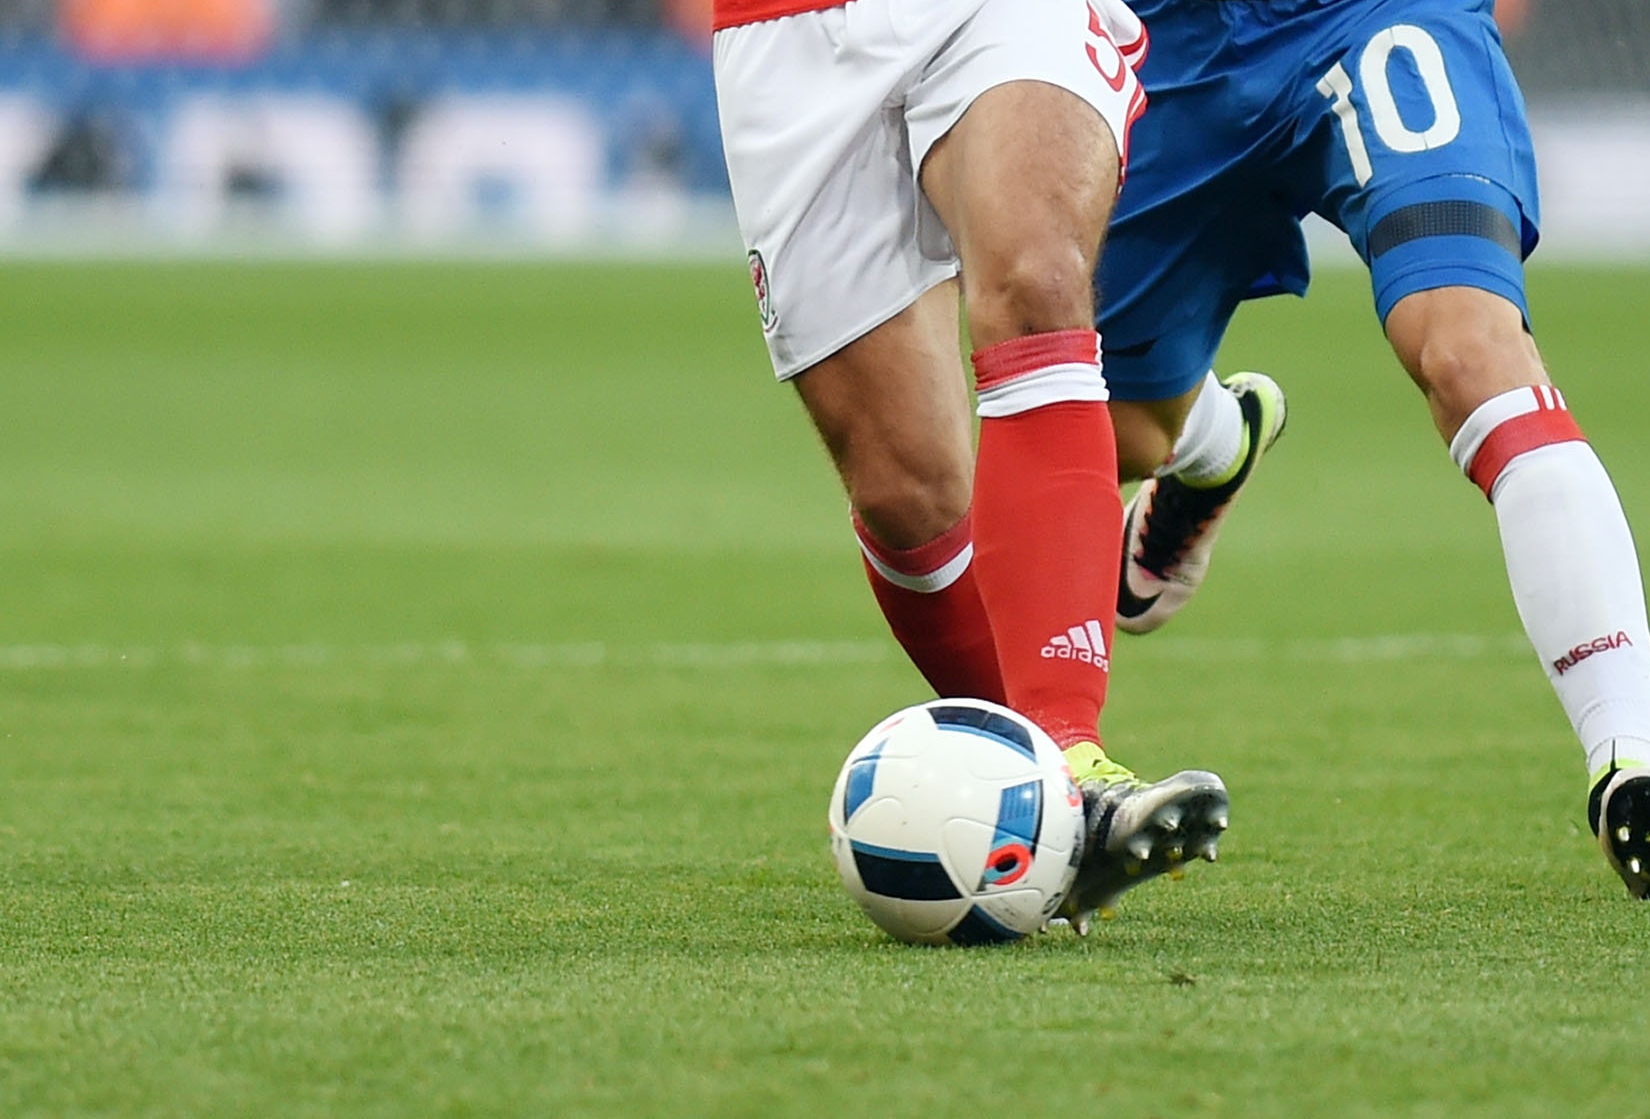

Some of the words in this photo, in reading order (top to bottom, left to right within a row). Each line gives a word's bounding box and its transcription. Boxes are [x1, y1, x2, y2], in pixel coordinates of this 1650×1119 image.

[1085, 0, 1126, 92] 5
[1316, 24, 1461, 189] 10
[1040, 644, 1109, 673] adidas
[1553, 631, 1633, 676] RUSSIA
